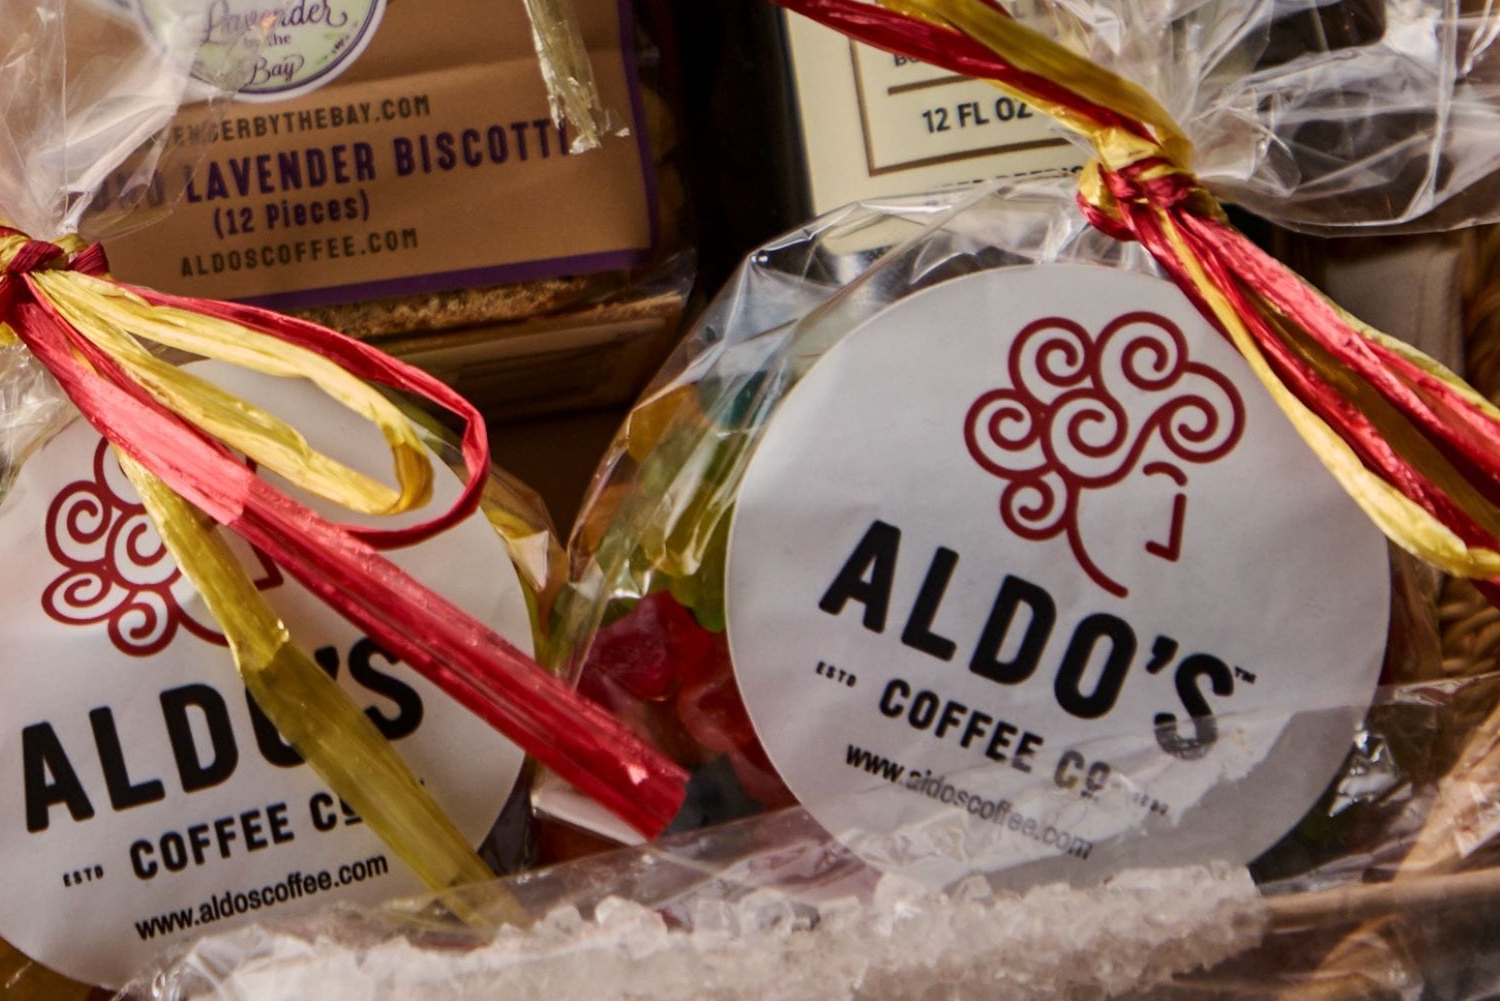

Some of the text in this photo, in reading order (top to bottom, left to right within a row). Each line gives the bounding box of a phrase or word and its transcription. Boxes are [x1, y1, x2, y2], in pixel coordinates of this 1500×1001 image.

[244, 54, 305, 85] Bay
[922, 95, 1035, 134] 12 FL OZ
[184, 140, 377, 204] LAVENDER
[393, 118, 571, 178] BISCOTTI
[180, 227, 420, 278] ALDOSCOFFEE.COM
[213, 207, 256, 240] (12
[818, 519, 1236, 762] ALDO'S
[814, 660, 858, 688] ESTD
[878, 677, 1045, 774] COFFEE
[61, 863, 105, 888] ESTD
[129, 801, 296, 881] COFFEE
[845, 742, 1094, 861] www.aldoscoffee.com
[134, 848, 390, 941] www.aldoscoffee.com
